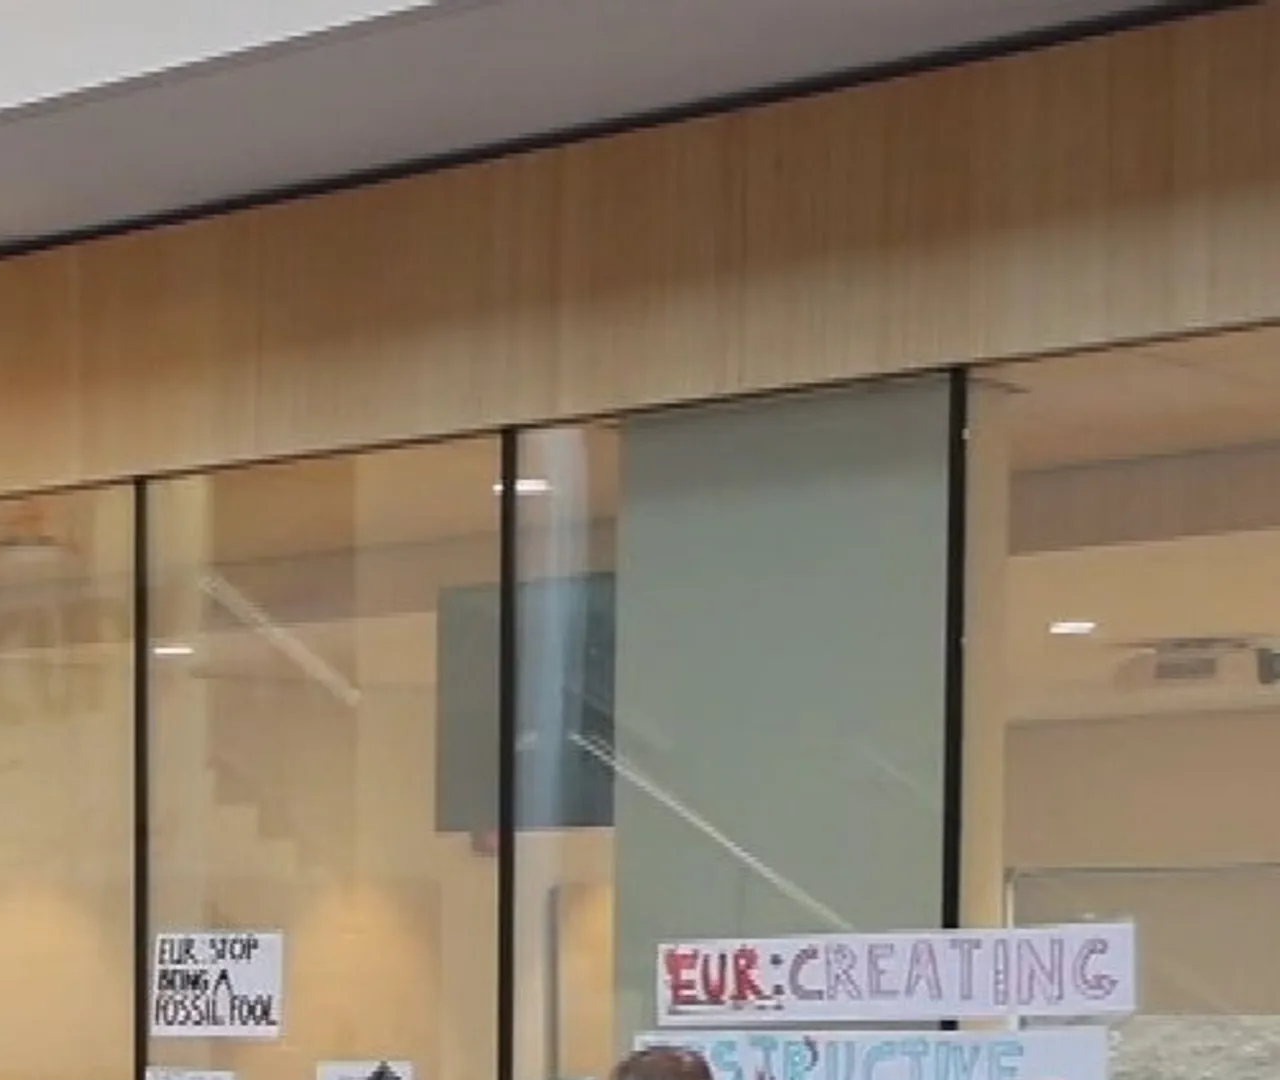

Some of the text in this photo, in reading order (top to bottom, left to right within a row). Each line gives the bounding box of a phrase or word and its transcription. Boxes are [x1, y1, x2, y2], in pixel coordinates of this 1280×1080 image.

[158, 967, 234, 996] BEING A
[155, 993, 278, 1026] FOSSIL FOOL
